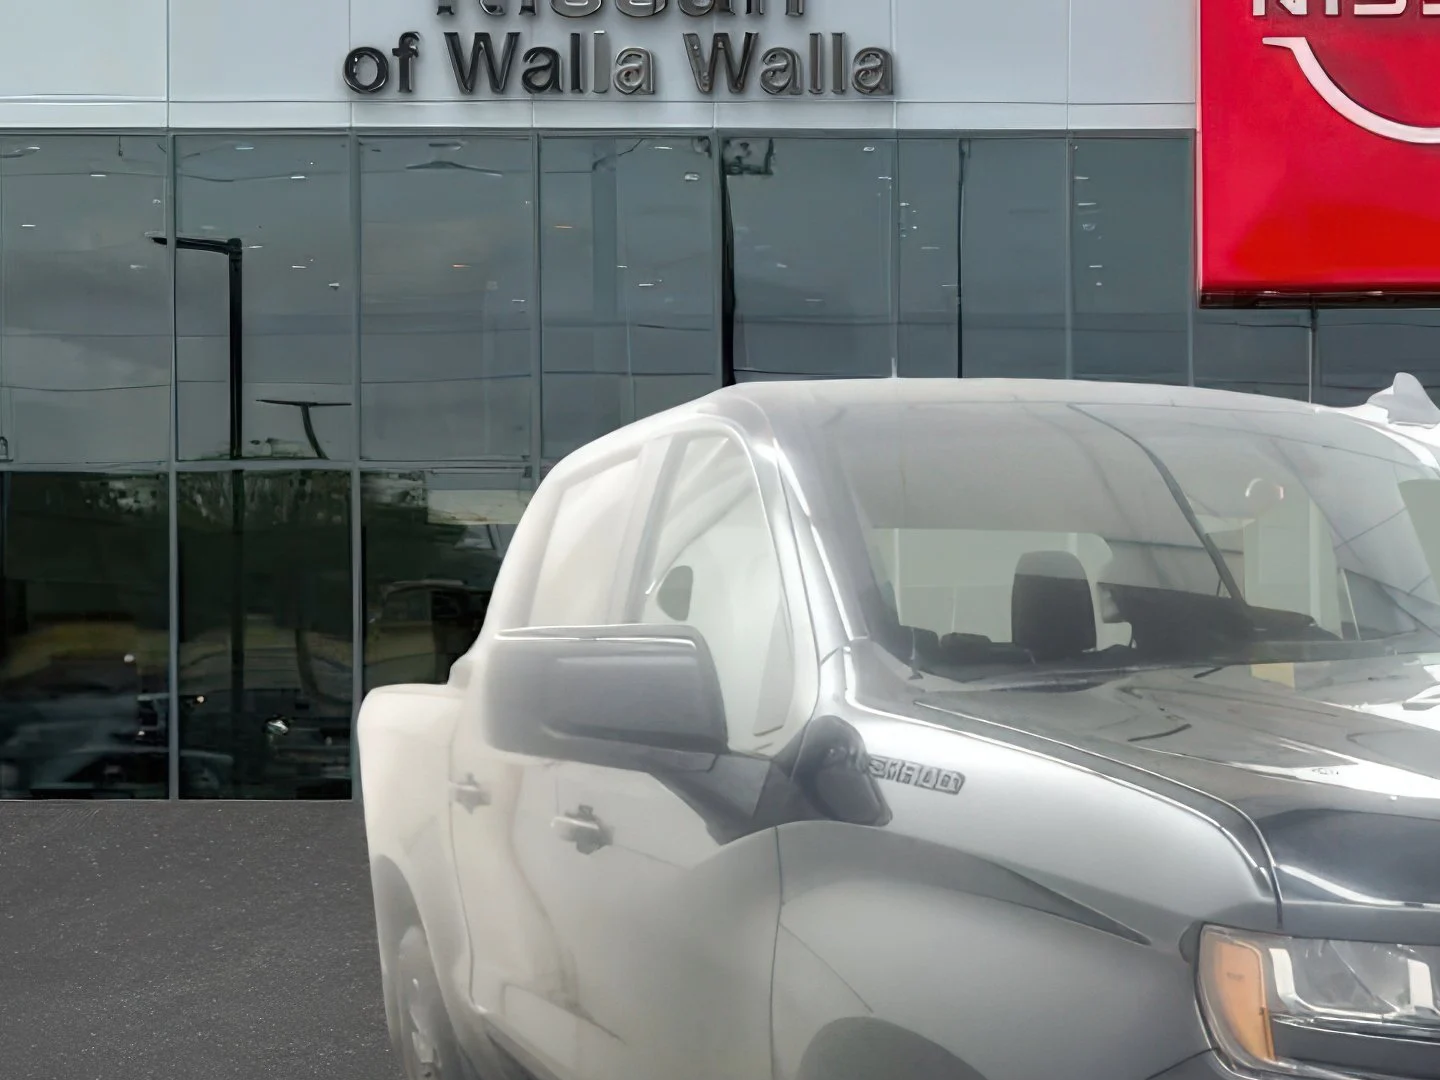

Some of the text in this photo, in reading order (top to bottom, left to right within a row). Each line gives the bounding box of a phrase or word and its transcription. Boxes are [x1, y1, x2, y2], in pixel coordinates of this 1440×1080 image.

[342, 31, 895, 95] of Walla Walla
